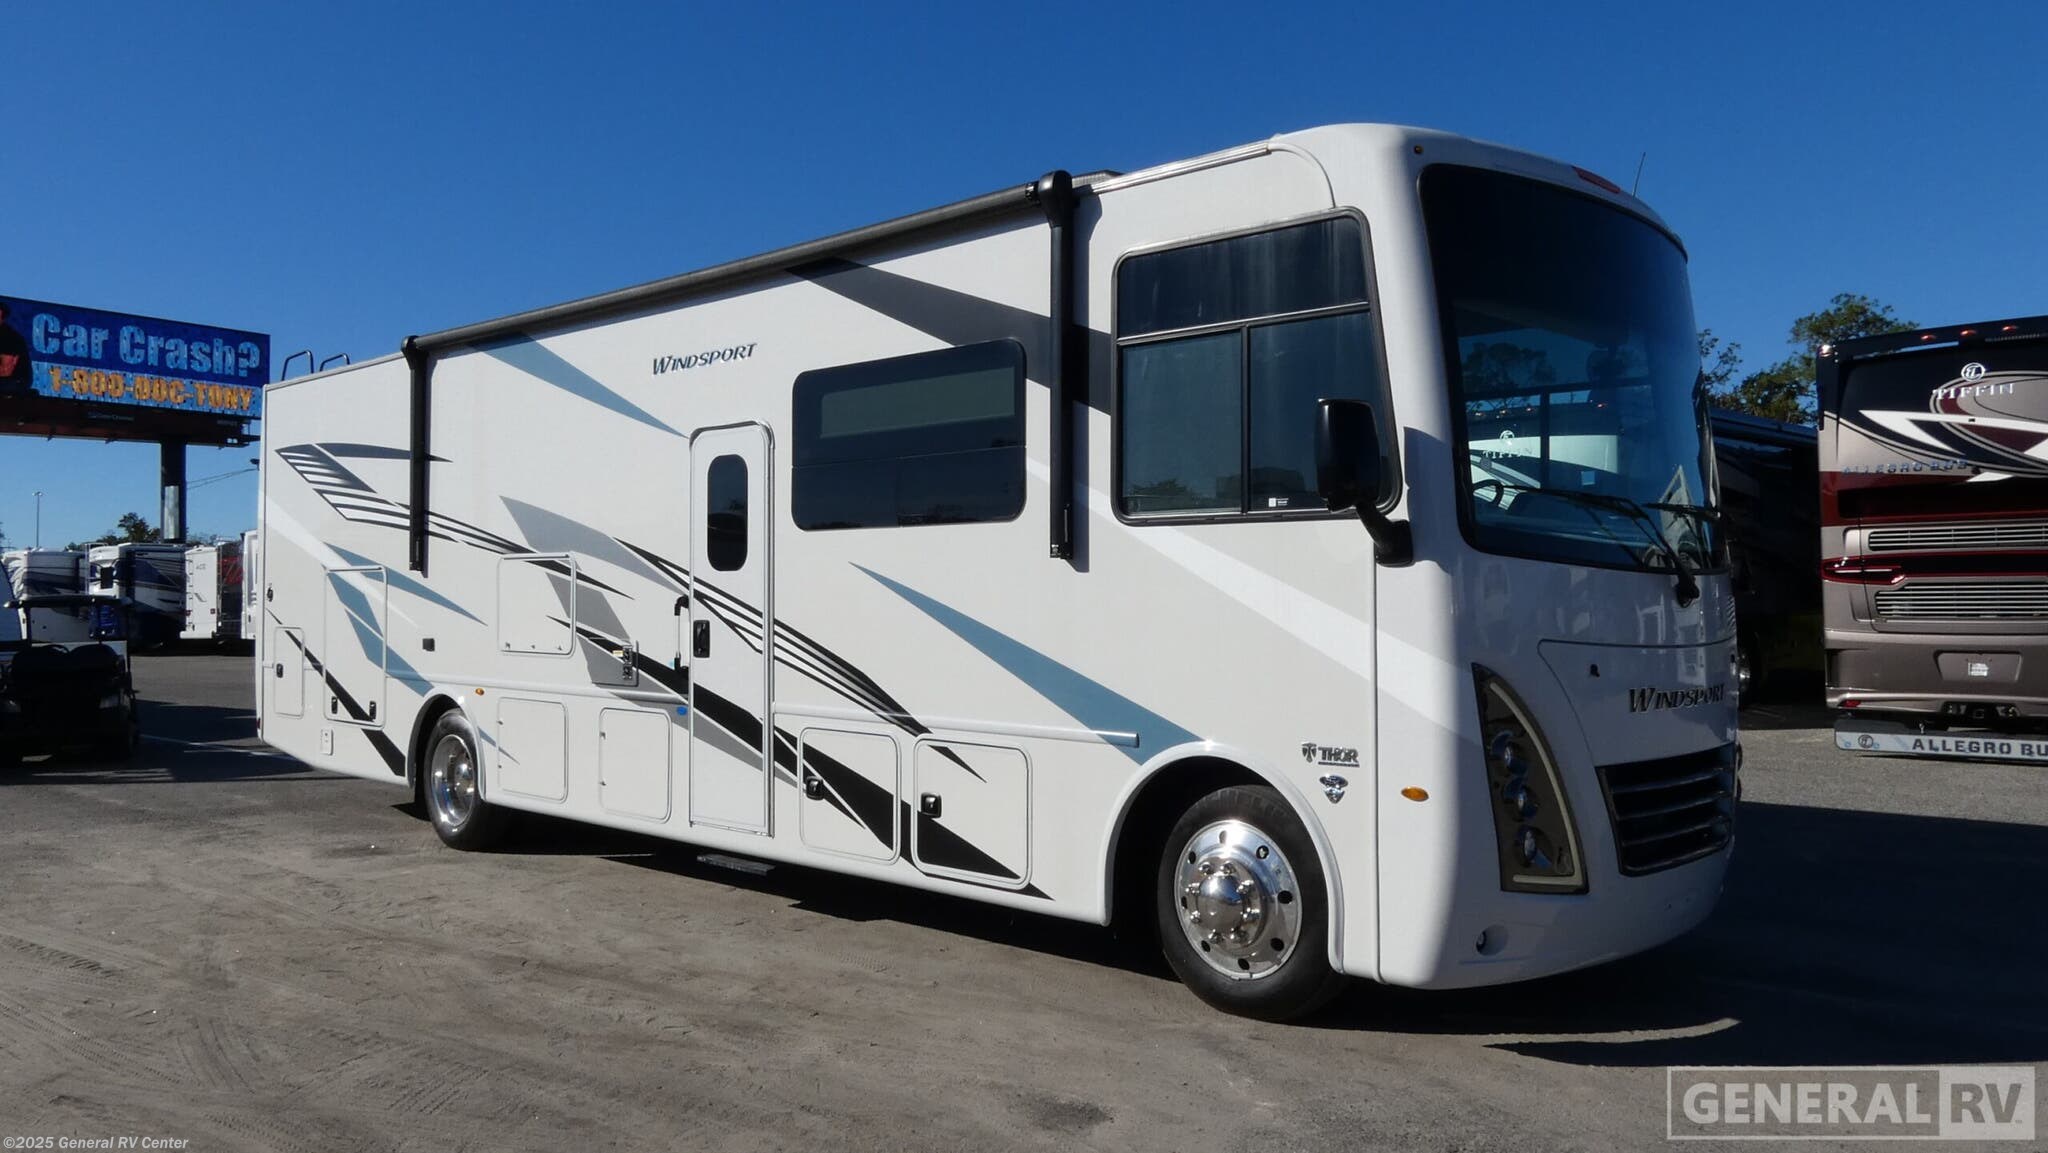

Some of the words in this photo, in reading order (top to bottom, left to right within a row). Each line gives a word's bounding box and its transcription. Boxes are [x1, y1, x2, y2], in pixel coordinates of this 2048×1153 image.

[32, 312, 109, 360] Car
[119, 325, 260, 377] Crash?
[653, 343, 757, 375] WINDSPORT
[49, 368, 253, 410] 1-800-DOC-TONY
[1932, 383, 2014, 400] TIFFIN
[1843, 462, 1922, 475] ALLEGRO
[1628, 683, 1726, 713] WINDSPORT
[1318, 746, 1358, 762] THOR
[1912, 739, 2011, 755] ALLEGRO
